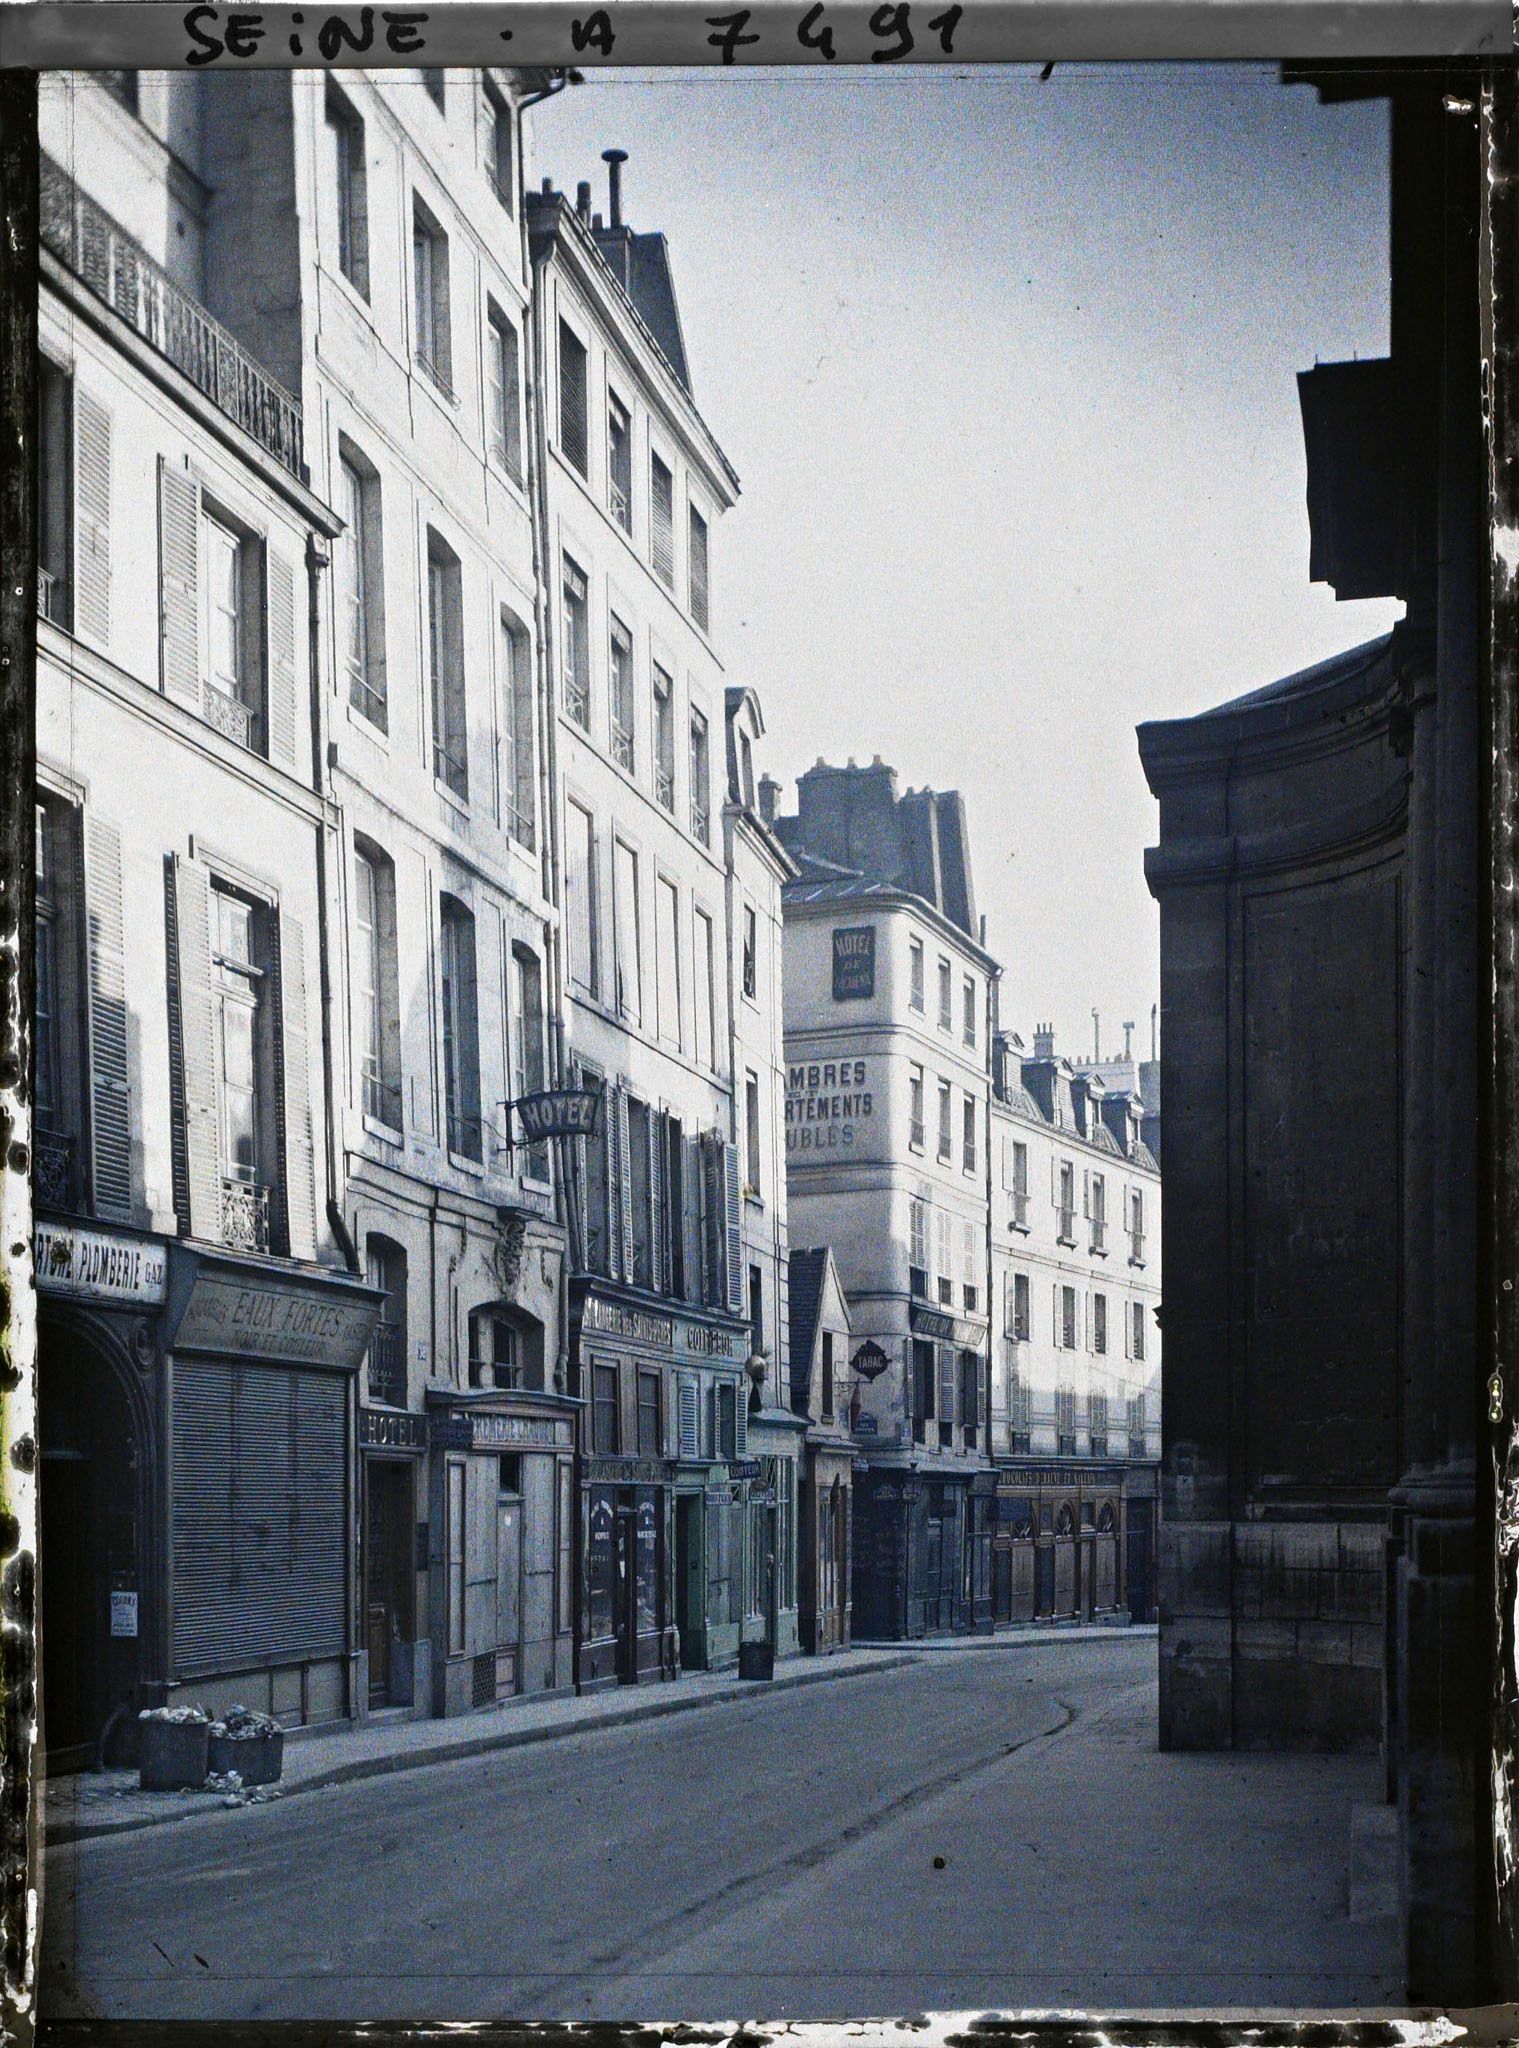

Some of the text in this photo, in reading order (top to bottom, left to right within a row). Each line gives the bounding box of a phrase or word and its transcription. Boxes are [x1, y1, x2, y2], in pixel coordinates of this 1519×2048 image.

[572, 10, 616, 56] A
[835, 934, 871, 957] HOTEL
[784, 1061, 866, 1090] MBRES
[523, 1095, 592, 1130] HOTEL
[79, 1241, 140, 1290] PLOMBERIE
[145, 1261, 162, 1285] GAZ
[231, 1292, 281, 1328] EAUX
[282, 1301, 345, 1338] FORTES
[858, 1355, 883, 1369] TABAC
[368, 1414, 417, 1446] HOTEL
